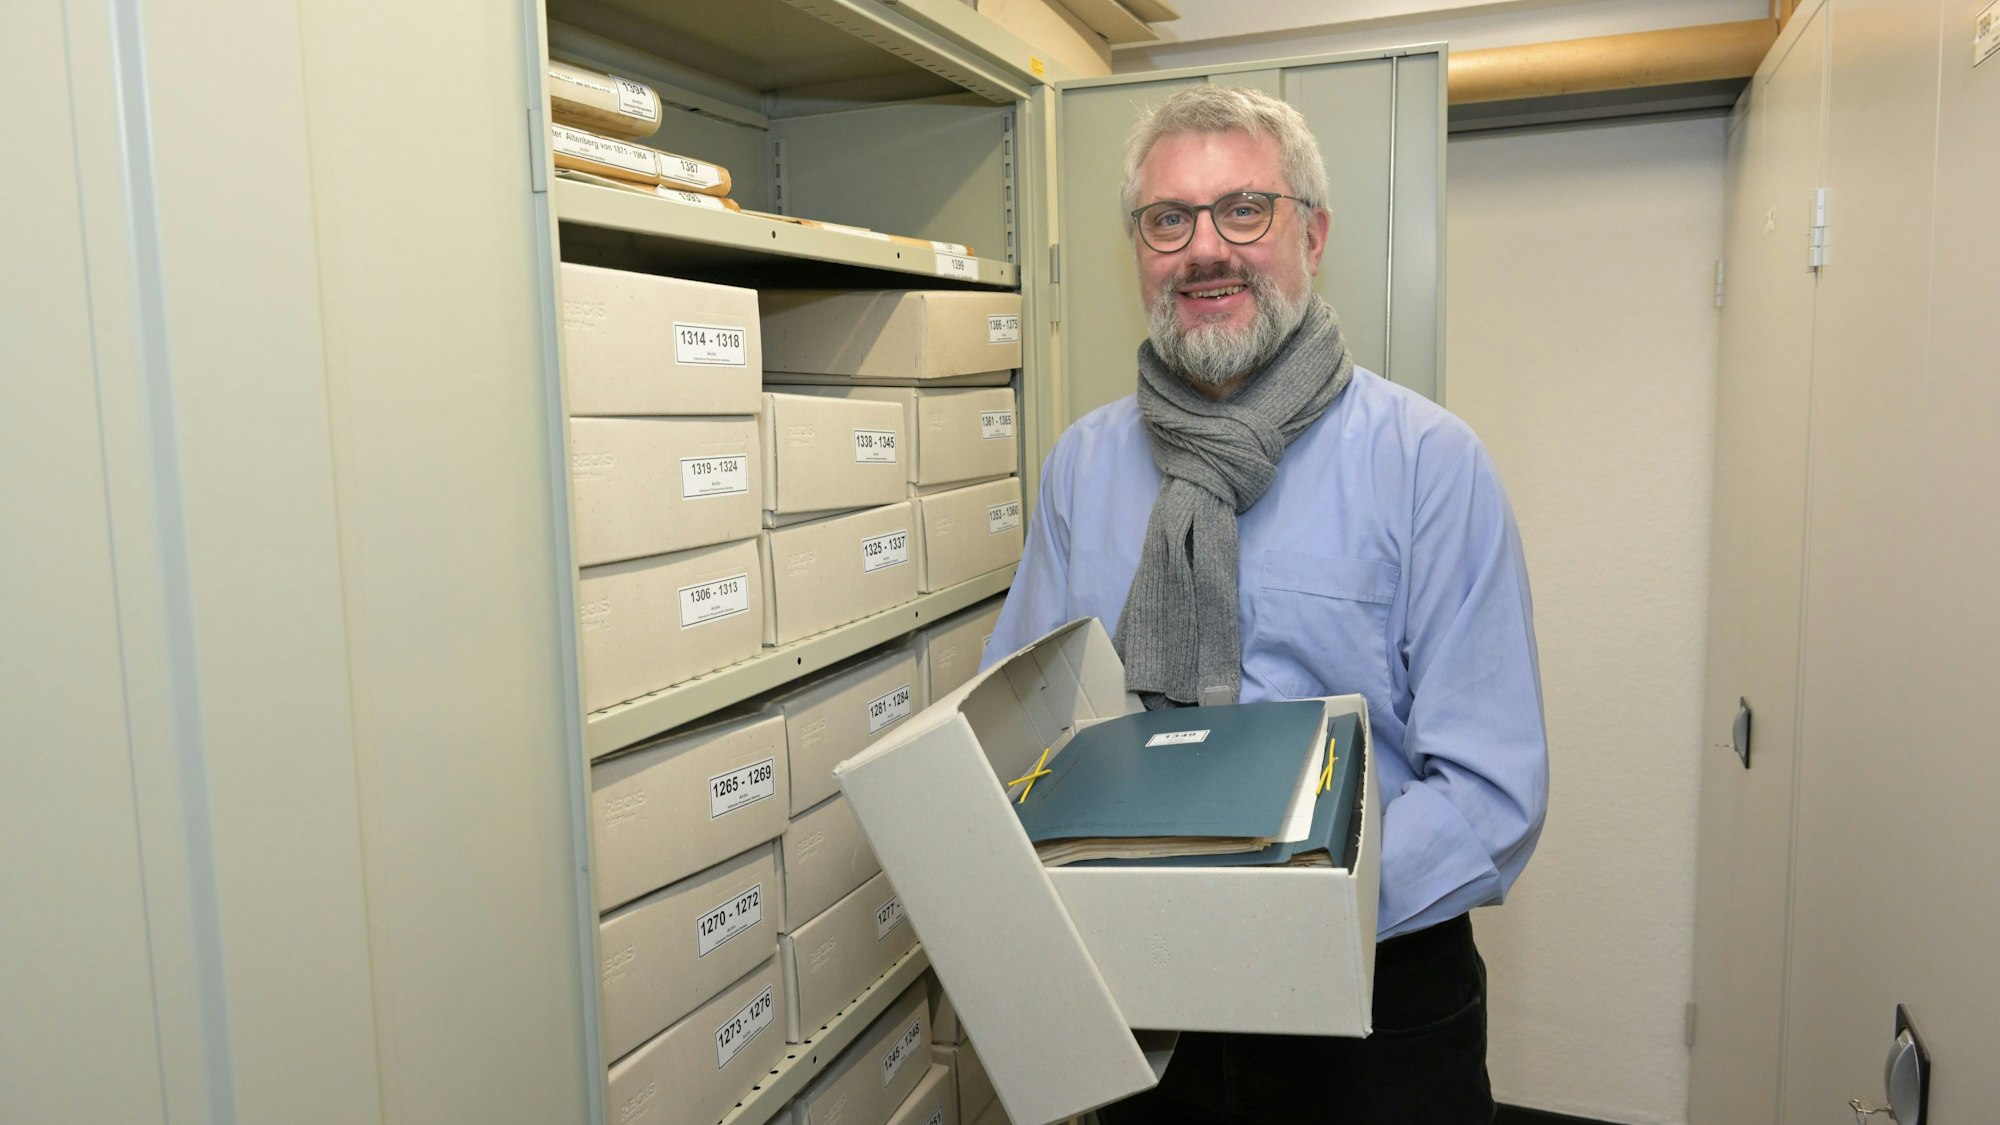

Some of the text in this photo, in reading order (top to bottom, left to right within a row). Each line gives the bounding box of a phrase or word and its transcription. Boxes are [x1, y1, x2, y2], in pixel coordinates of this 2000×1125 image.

[622, 82, 646, 97] 1394
[565, 132, 599, 149] Altenberg
[600, 144, 612, 152] von
[613, 145, 628, 155] 1871
[632, 150, 647, 160] 1964
[680, 160, 698, 174] 1387
[951, 259, 965, 271] 1399
[681, 330, 706, 346] 1314
[716, 333, 740, 348] 1318
[856, 435, 873, 448] 1338
[878, 436, 895, 449] 1345
[692, 462, 712, 475] 1319
[719, 460, 738, 473] 1324
[864, 541, 883, 557] 1325
[889, 535, 906, 551] 1337
[690, 587, 711, 603] 1306
[718, 581, 738, 596] 1313
[870, 699, 887, 718] 1281
[893, 690, 909, 707] 1284
[713, 776, 739, 798] 1265
[747, 765, 771, 786] 1269
[700, 910, 726, 937] 1270
[735, 891, 759, 916] 1272
[878, 902, 895, 925] 1277
[718, 1018, 742, 1048] 1273
[749, 993, 771, 1021] 1276
[884, 1046, 900, 1072] 1245
